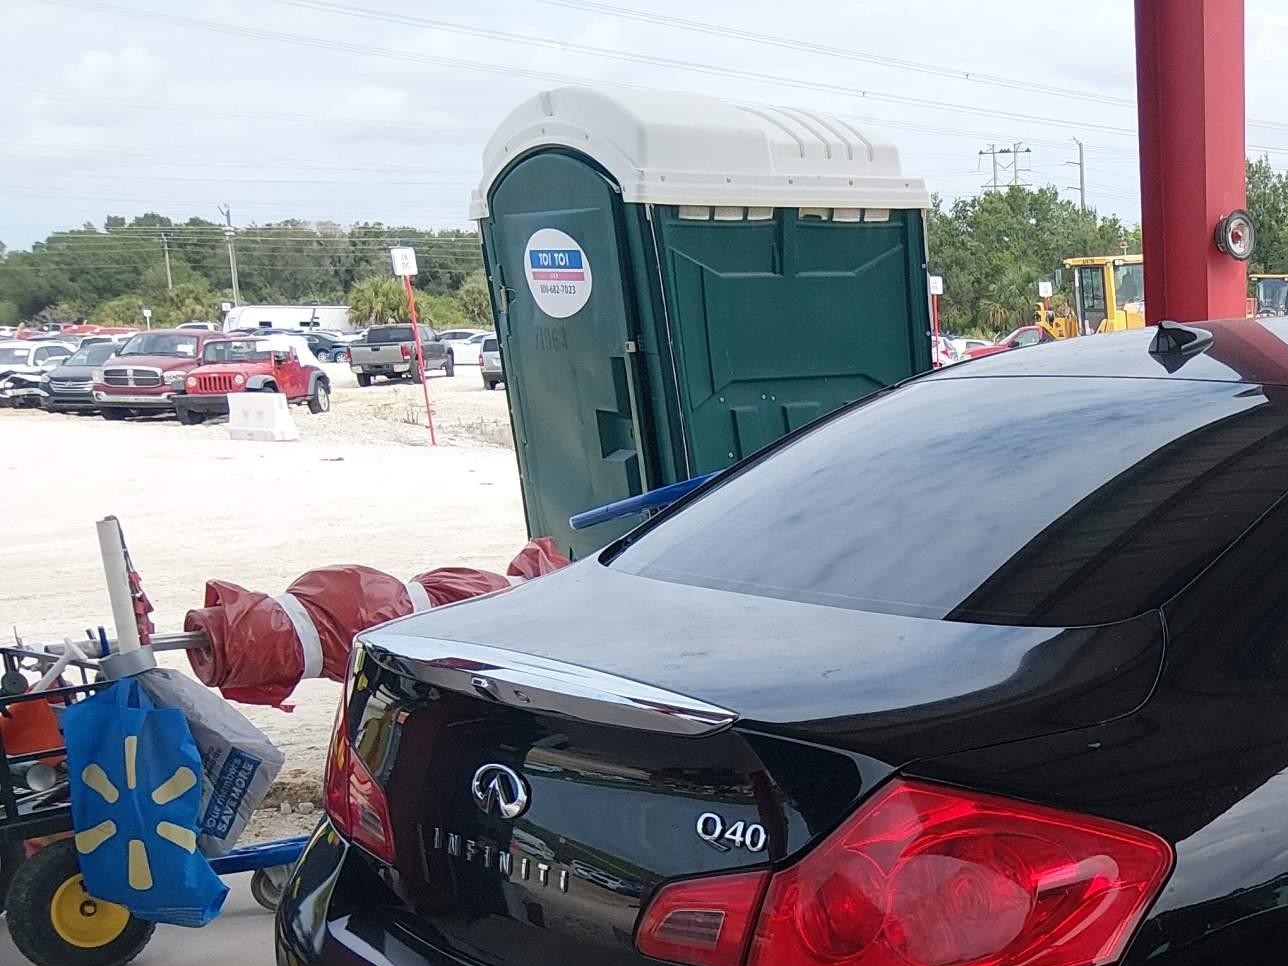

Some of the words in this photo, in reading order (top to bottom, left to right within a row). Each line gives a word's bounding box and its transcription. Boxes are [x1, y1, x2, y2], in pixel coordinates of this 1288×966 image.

[538, 252, 552, 266] TOI
[554, 252, 570, 266] TOI
[218, 797, 238, 832] SAVE
[230, 761, 253, 799] MORE
[206, 806, 222, 828] Our
[697, 812, 766, 852] Q40
[434, 827, 569, 894] INFINITI
